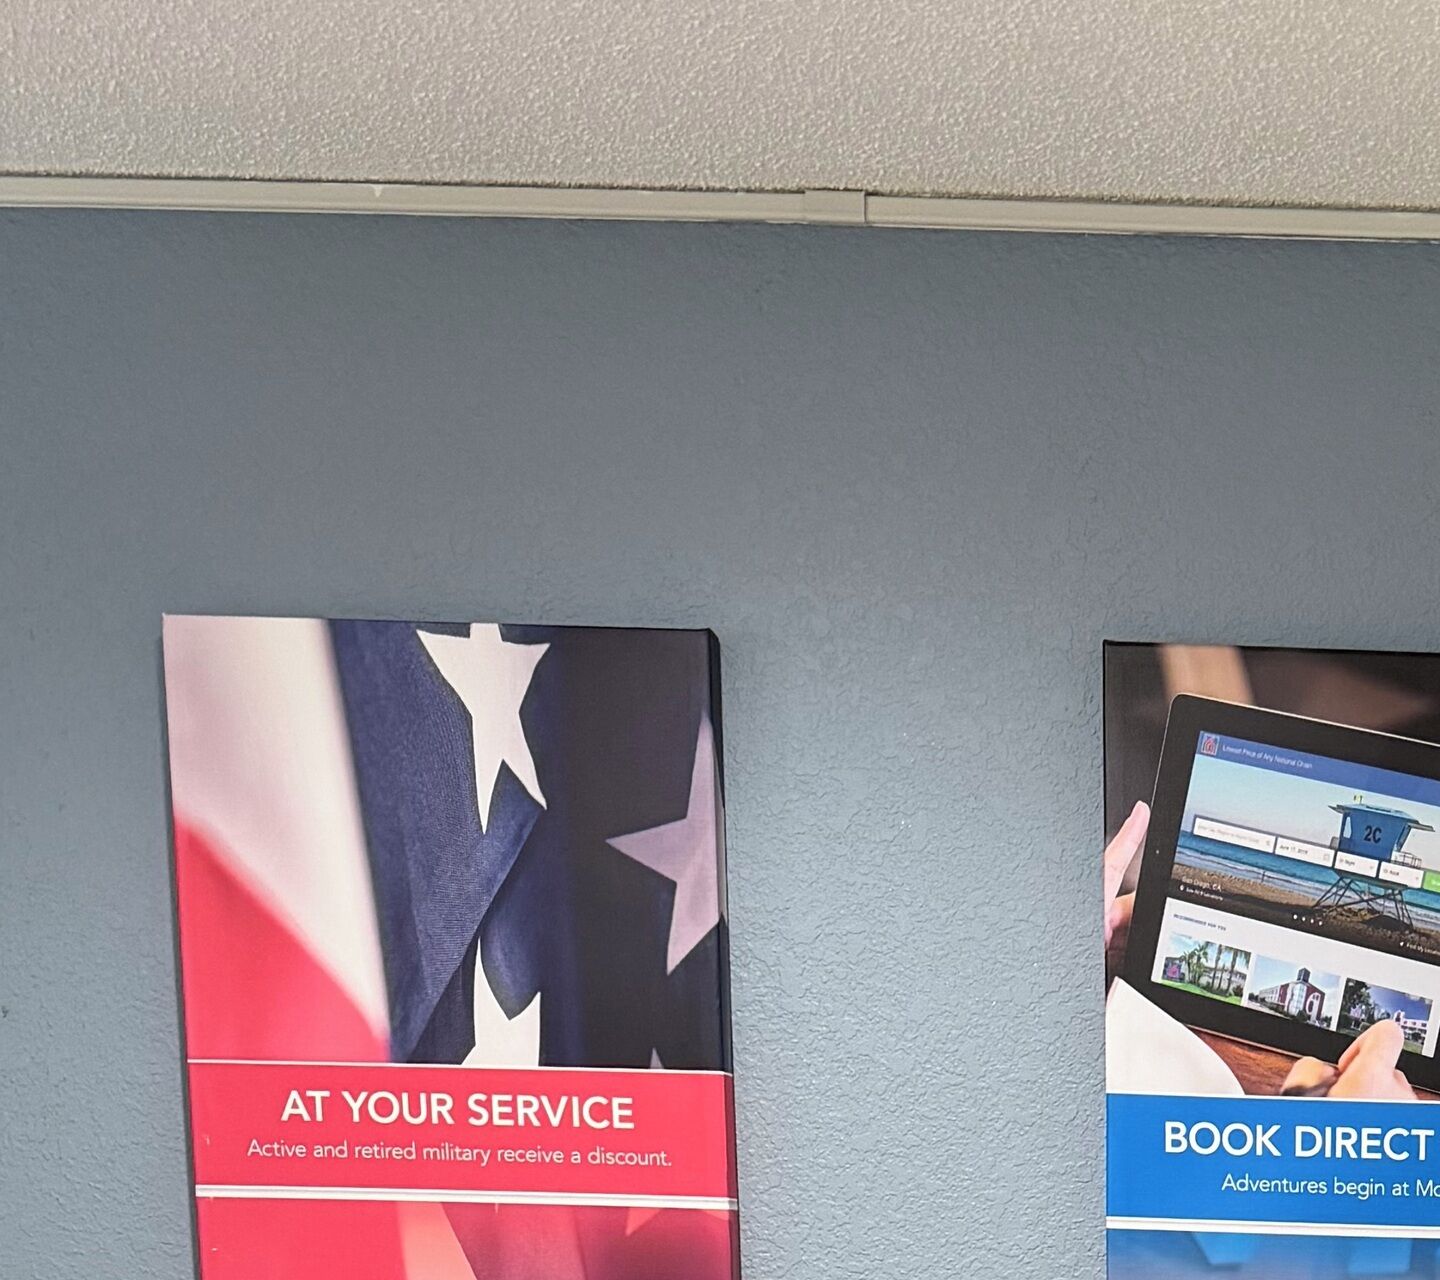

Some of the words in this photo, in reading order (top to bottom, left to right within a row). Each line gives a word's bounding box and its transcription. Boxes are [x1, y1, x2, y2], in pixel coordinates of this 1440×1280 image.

[1363, 825, 1382, 843] 2C
[280, 1089, 329, 1123] AT
[341, 1090, 456, 1126] YOUR
[467, 1092, 635, 1130] SERVICE
[247, 1138, 307, 1159] Active
[313, 1140, 349, 1160] and
[354, 1141, 416, 1161] retired
[422, 1142, 491, 1167] military
[497, 1146, 564, 1164] receive
[570, 1151, 581, 1165] a
[587, 1145, 672, 1167] discount.
[1163, 1121, 1281, 1158] BOOK
[1294, 1125, 1435, 1163] DIRECT
[1221, 1172, 1327, 1196] Adventures
[1333, 1176, 1386, 1200] begin
[1392, 1181, 1411, 1198] at
